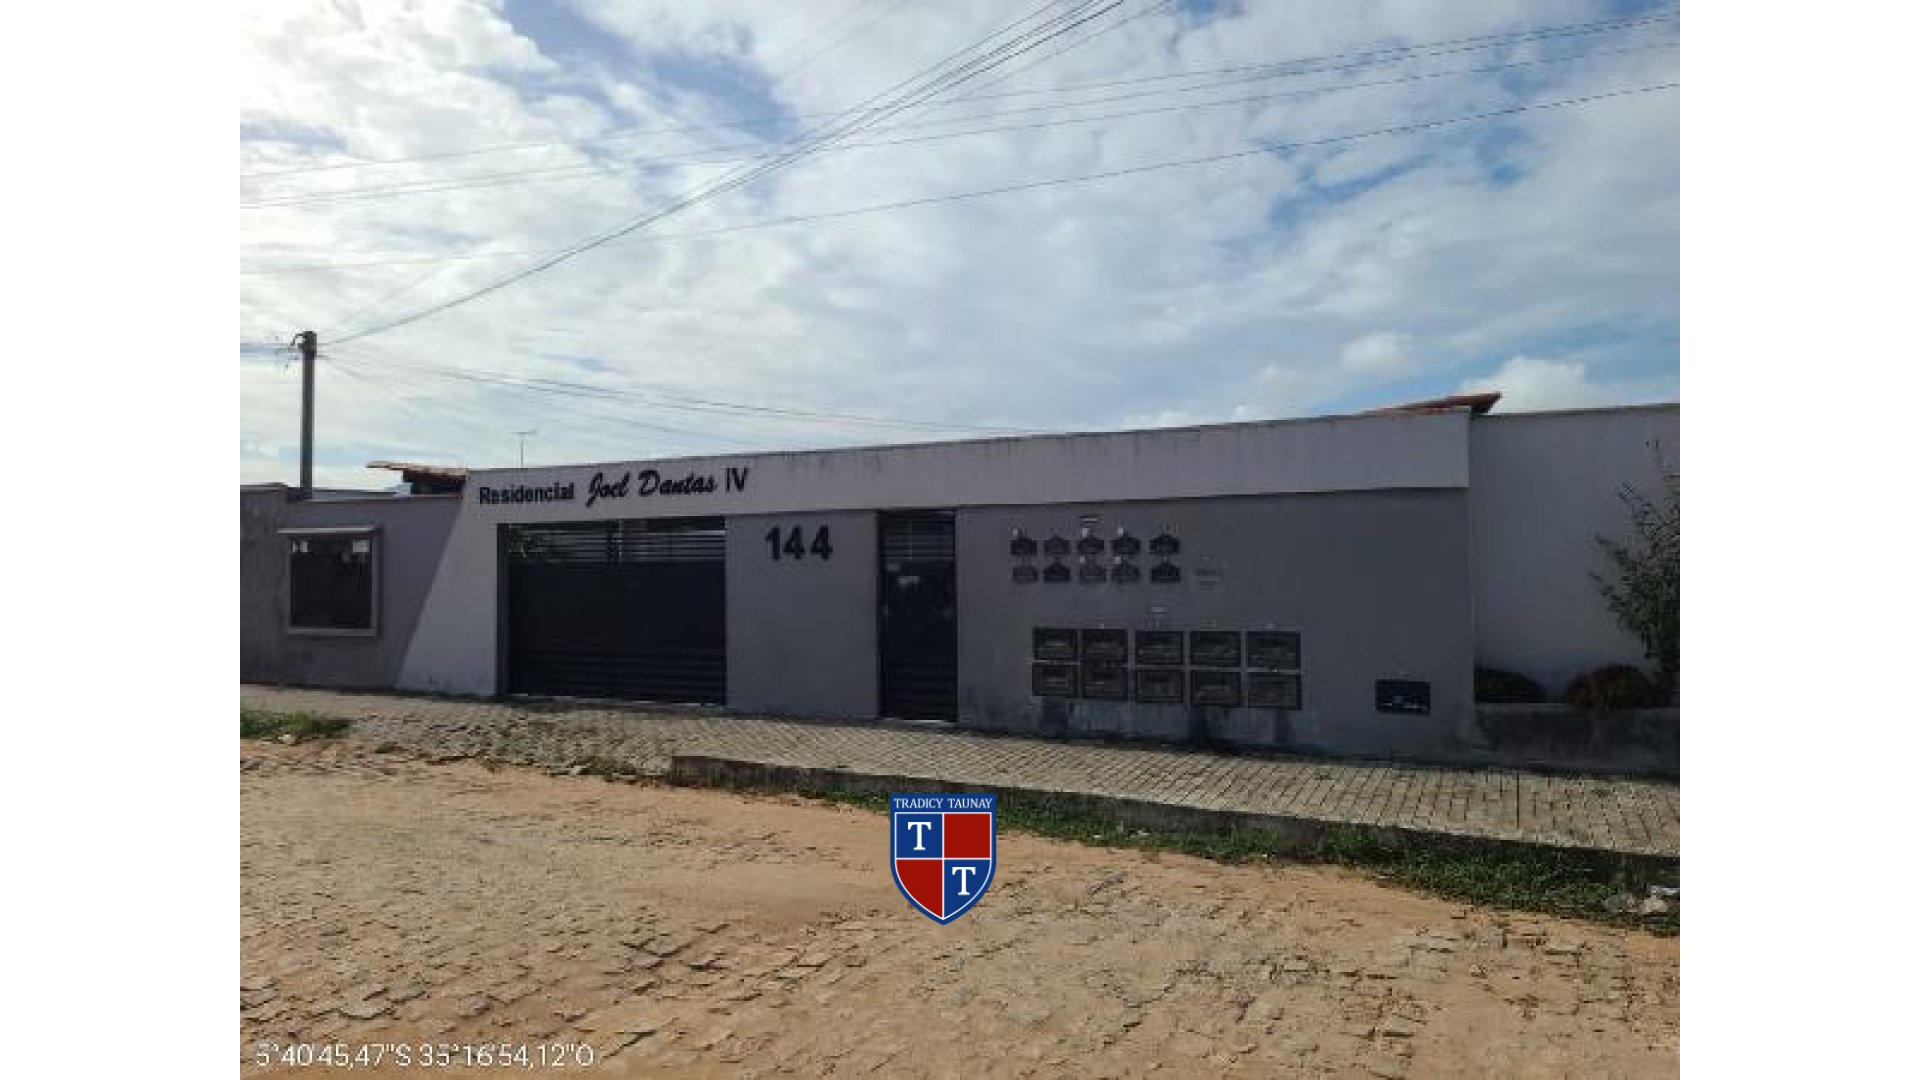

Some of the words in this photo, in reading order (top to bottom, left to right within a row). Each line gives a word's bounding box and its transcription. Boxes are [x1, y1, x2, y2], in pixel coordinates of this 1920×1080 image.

[479, 482, 574, 505] Residencial
[586, 472, 631, 508] Joel
[638, 469, 717, 496] Dantas
[725, 467, 750, 493] IV
[765, 525, 833, 562] 144
